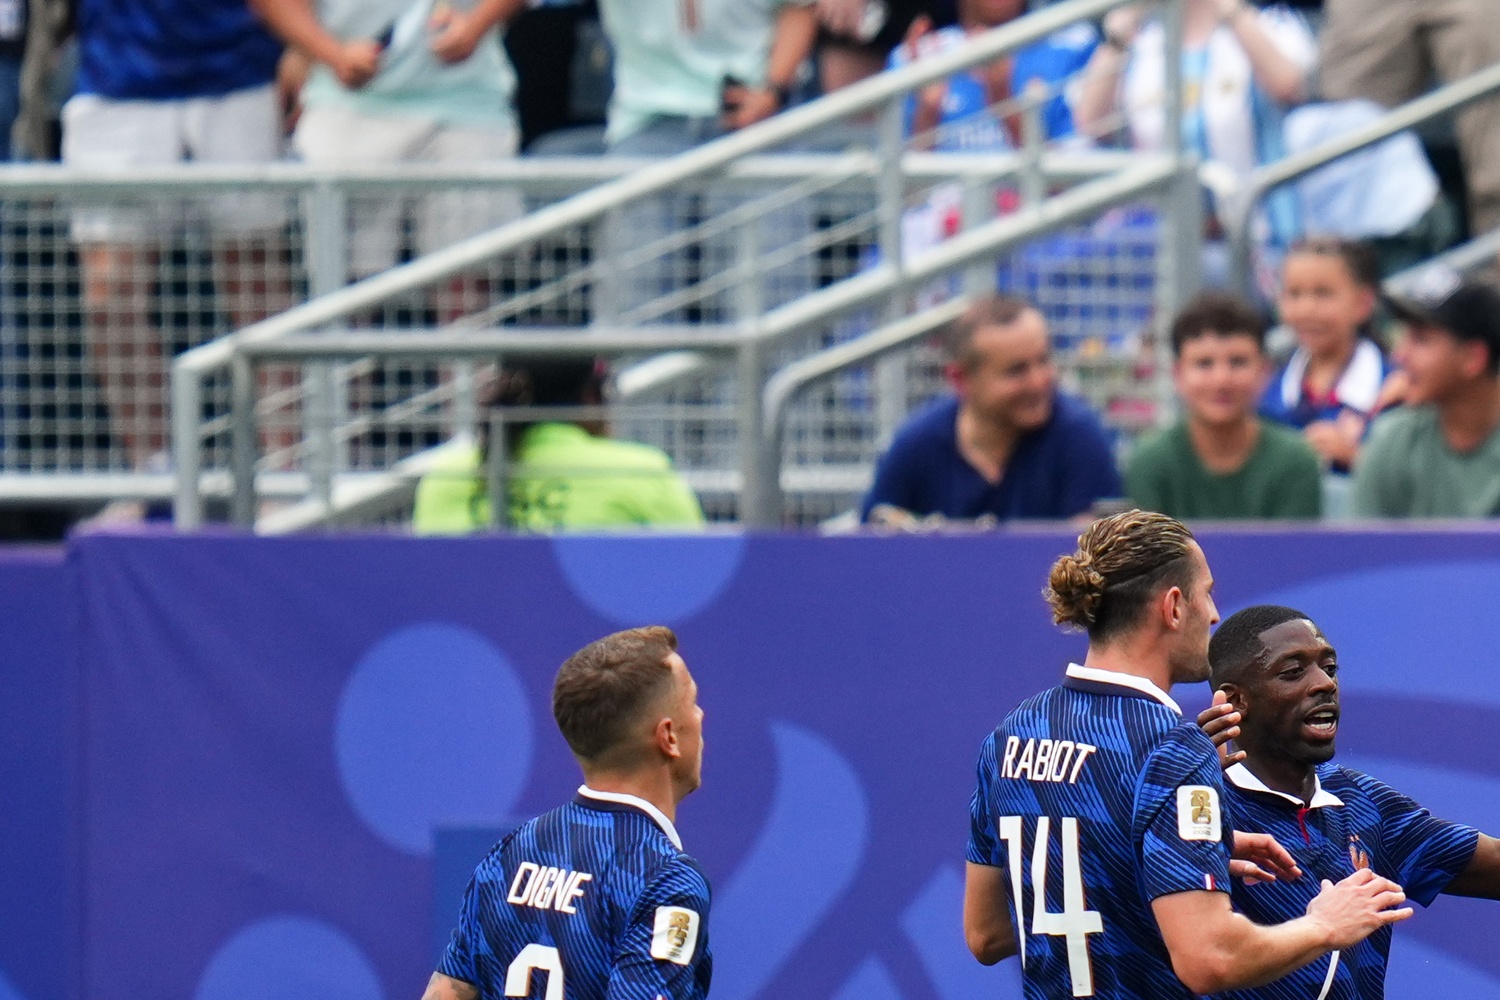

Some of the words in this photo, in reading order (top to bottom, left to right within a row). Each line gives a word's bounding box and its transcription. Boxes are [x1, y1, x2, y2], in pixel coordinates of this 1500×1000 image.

[1000, 735, 1096, 784] RABIOT
[507, 861, 592, 915] DIGNE
[999, 815, 1104, 997] 14
